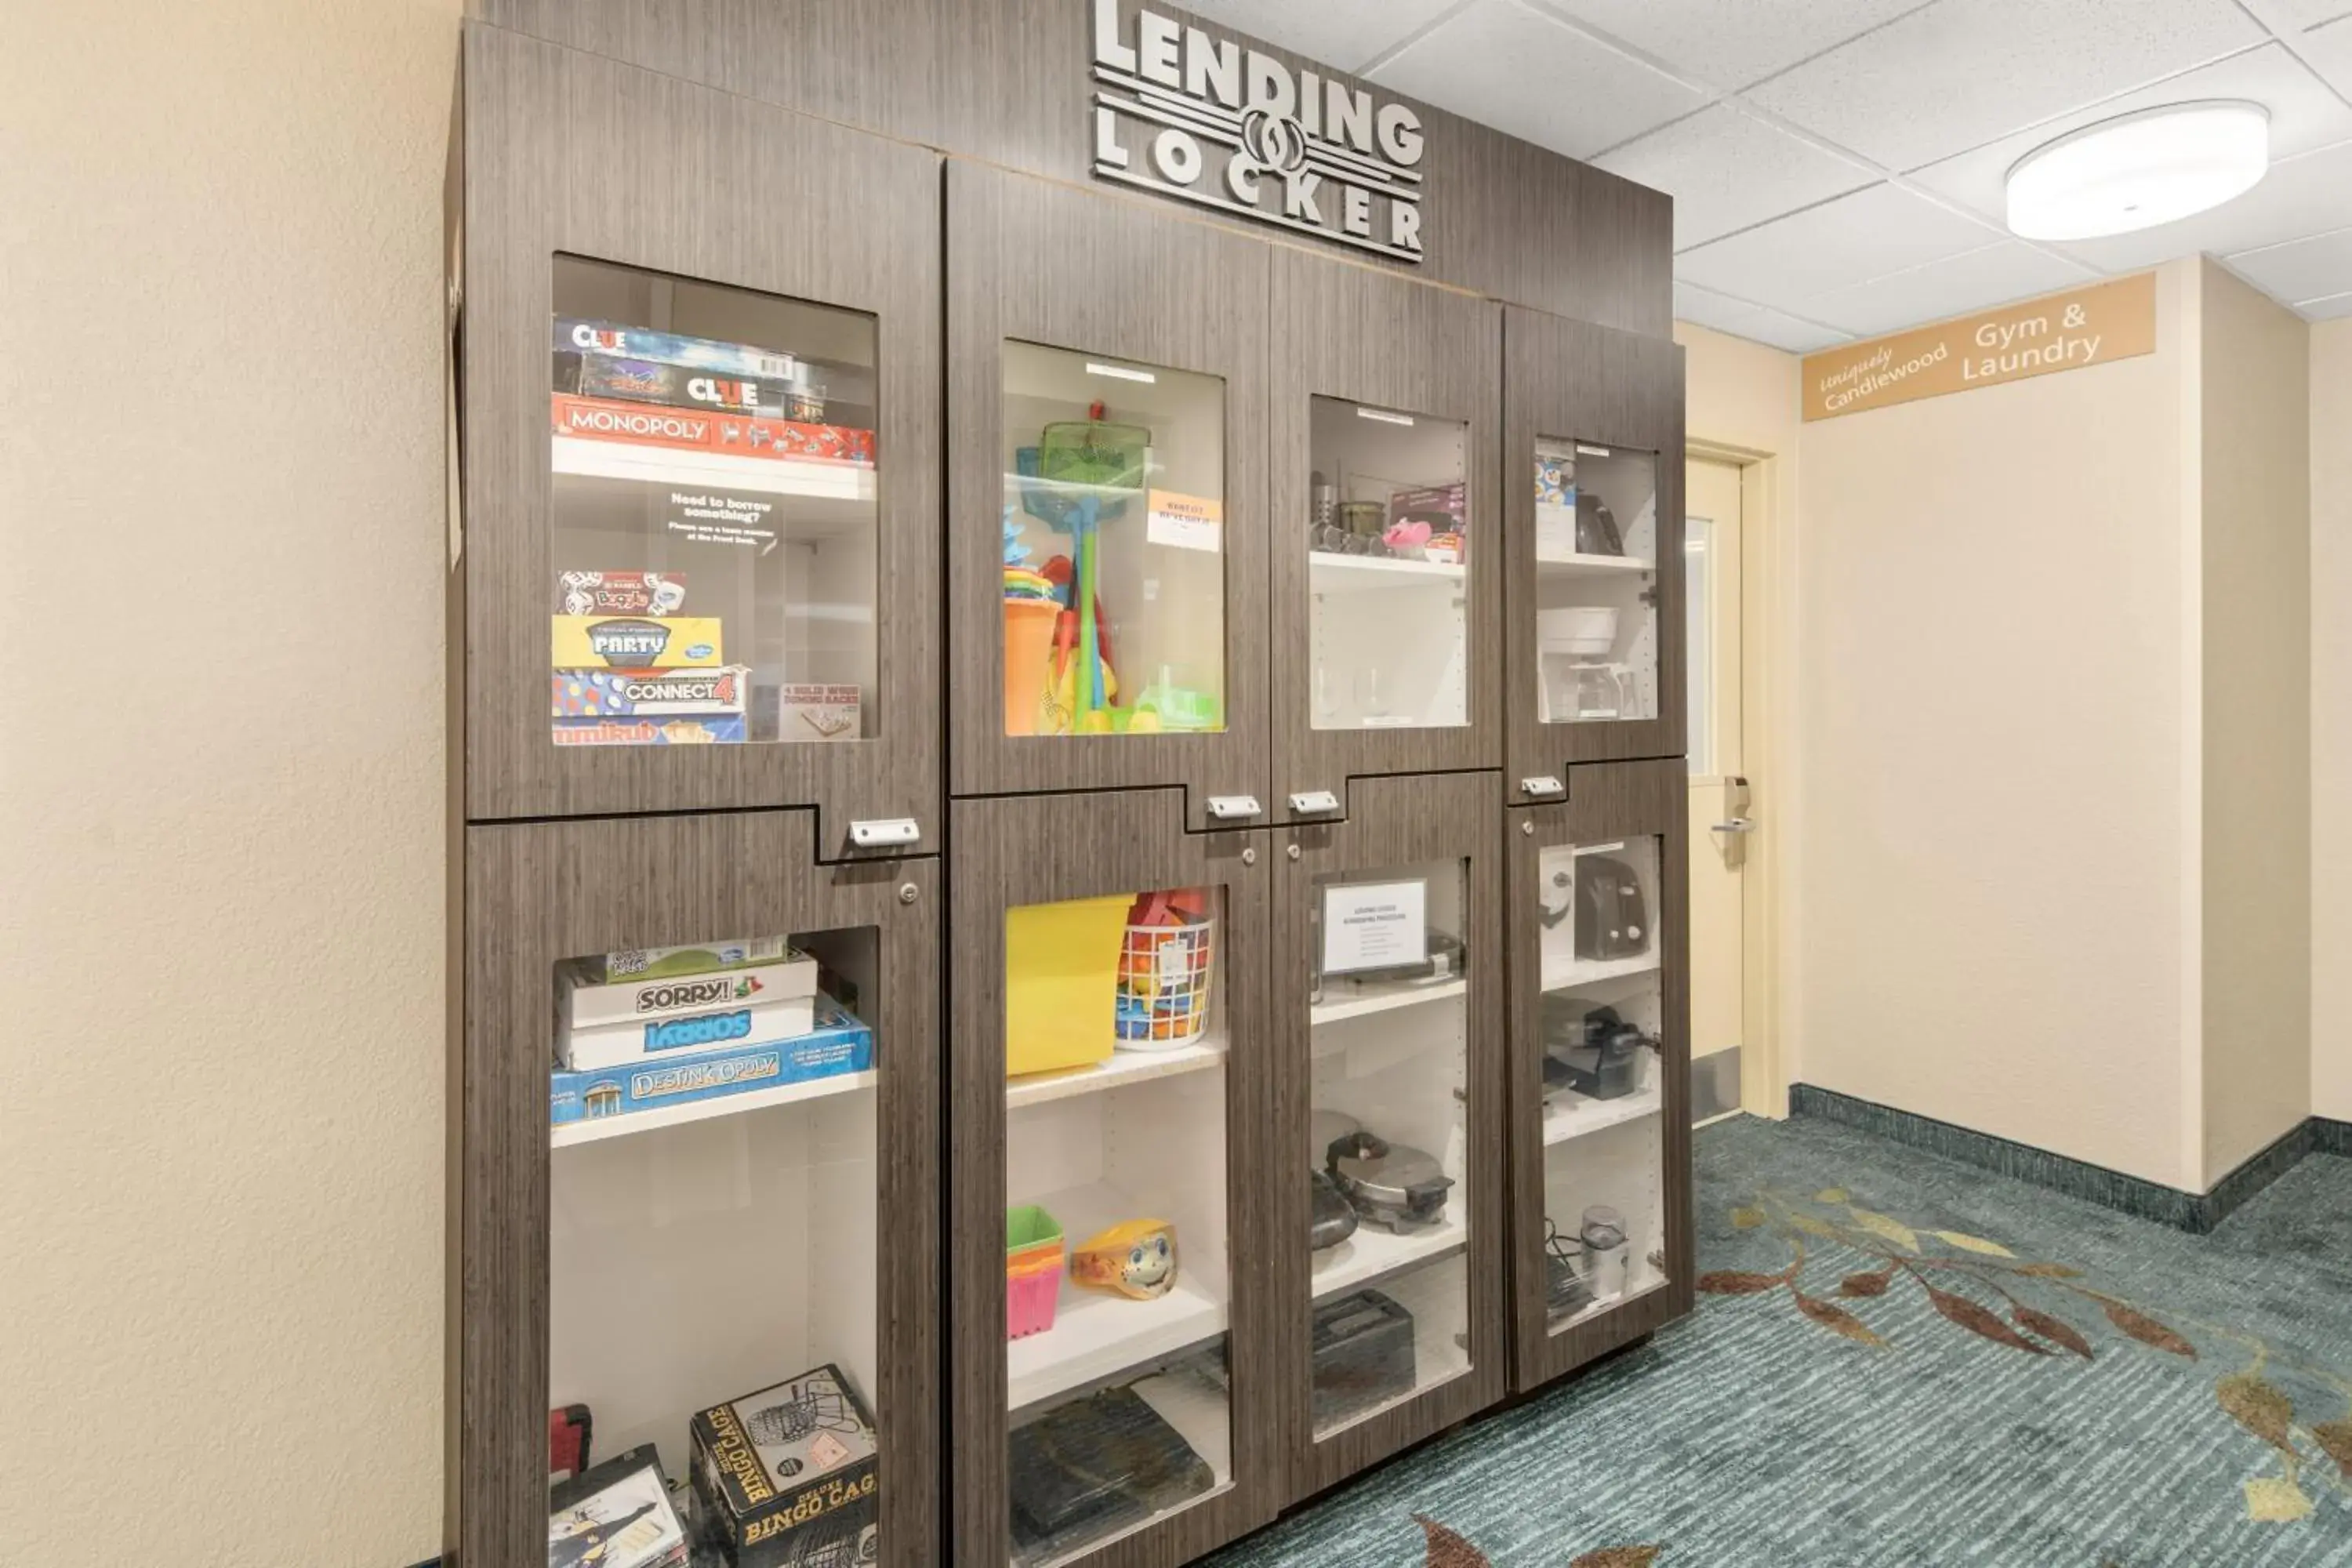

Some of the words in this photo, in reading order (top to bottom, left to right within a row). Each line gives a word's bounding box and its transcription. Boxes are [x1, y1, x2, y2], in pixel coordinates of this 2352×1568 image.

[1094, 0, 1424, 165] LENDING
[1096, 106, 1422, 251] LOCKER
[572, 324, 626, 349] CLUE
[1975, 317, 2048, 350] Gym
[2063, 303, 2085, 328] &
[1963, 335, 2101, 380] Laundry
[687, 377, 759, 405] CLUE
[1825, 342, 1948, 411] Candlewood
[572, 410, 706, 440] MONOPOLY
[671, 492, 706, 506] Need
[709, 496, 724, 507] to
[727, 498, 772, 512] borrow
[684, 507, 760, 524] something?
[594, 636, 665, 653] PARTY
[626, 683, 715, 700] CONNECT
[713, 674, 735, 704] 4
[552, 722, 657, 743] mmikub
[640, 981, 729, 1011] SORRY!
[729, 1449, 769, 1504] BINGO
[745, 1497, 822, 1542] BINGO
[828, 1472, 877, 1506] CAG
